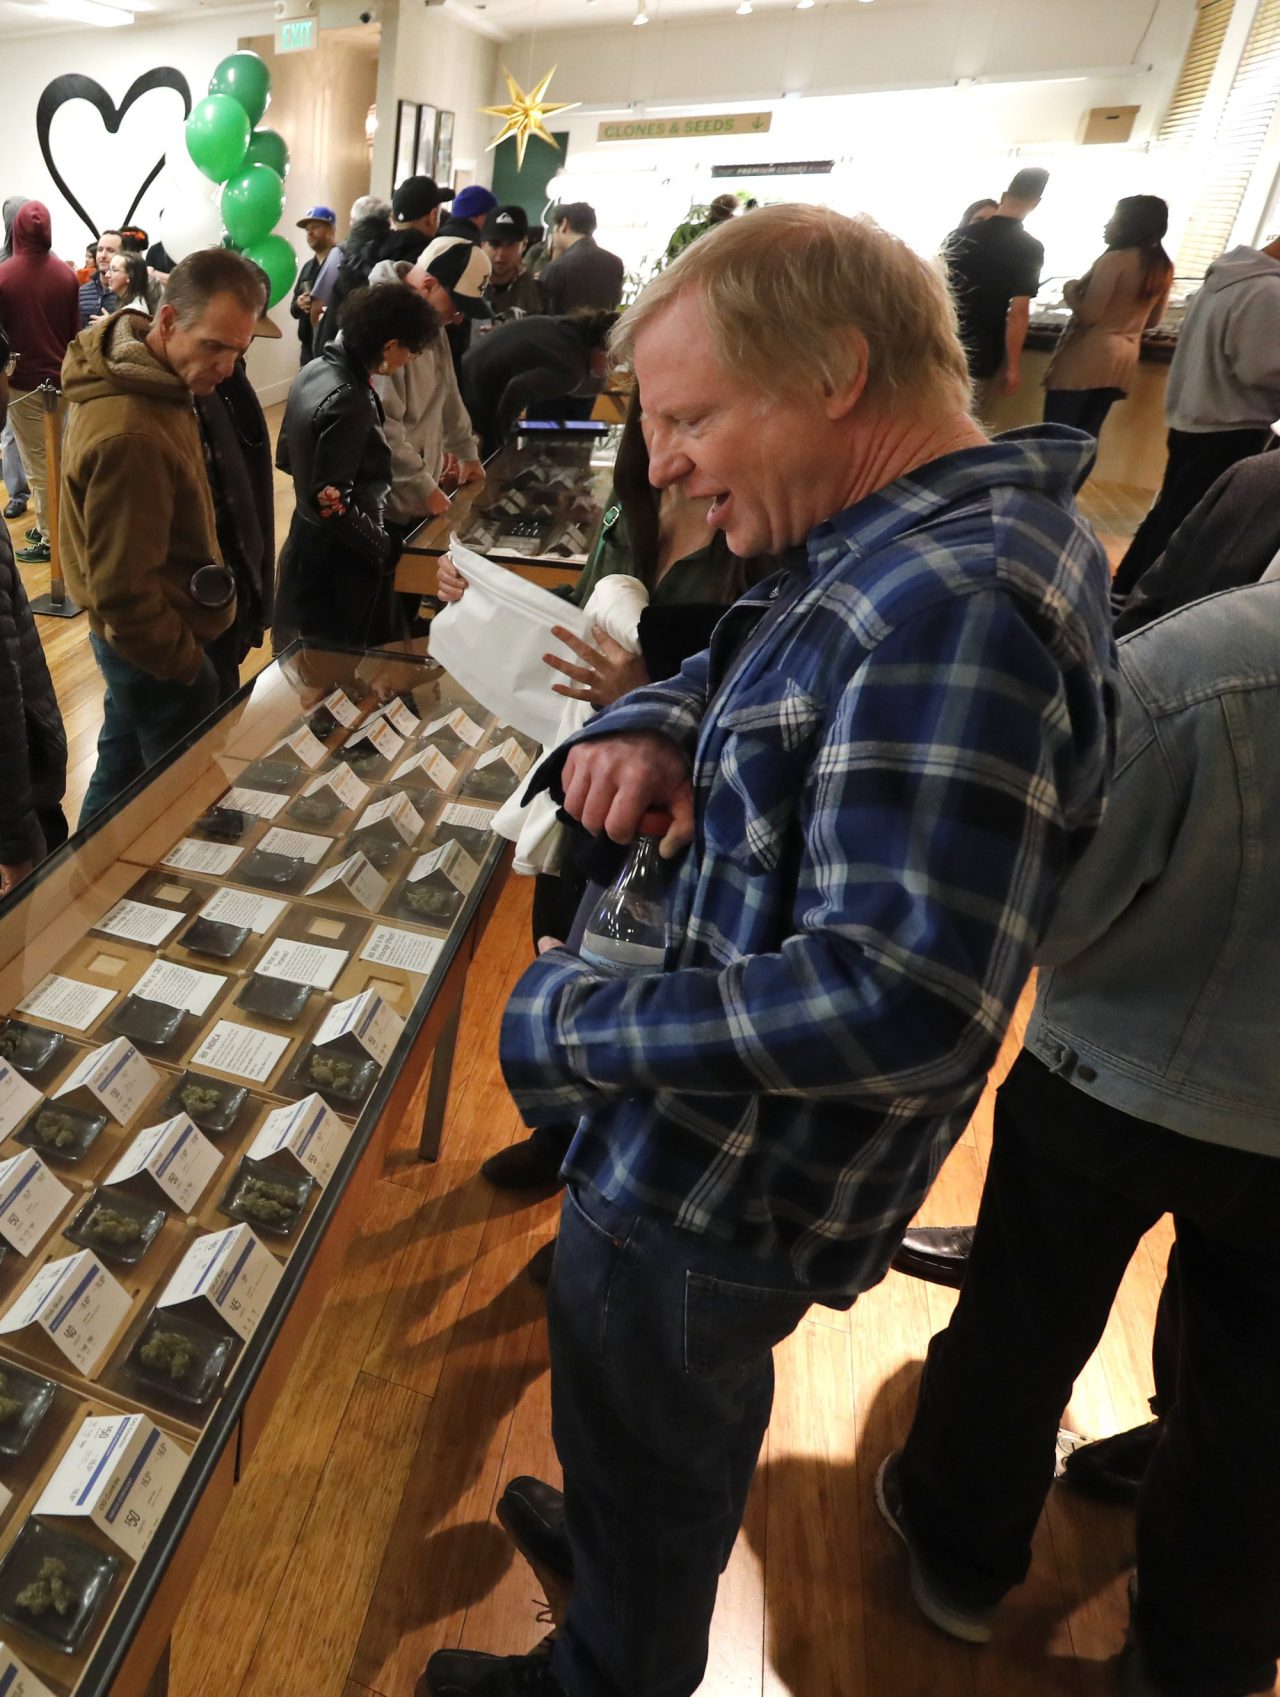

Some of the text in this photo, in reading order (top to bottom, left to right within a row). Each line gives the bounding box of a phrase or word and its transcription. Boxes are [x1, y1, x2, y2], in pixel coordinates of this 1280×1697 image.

[281, 21, 312, 49] EXIT
[604, 118, 734, 138] CLONES & SEEDS
[204, 1031, 223, 1051] INDICA
[61, 1323, 79, 1341] $40
[122, 1508, 143, 1530] $50
